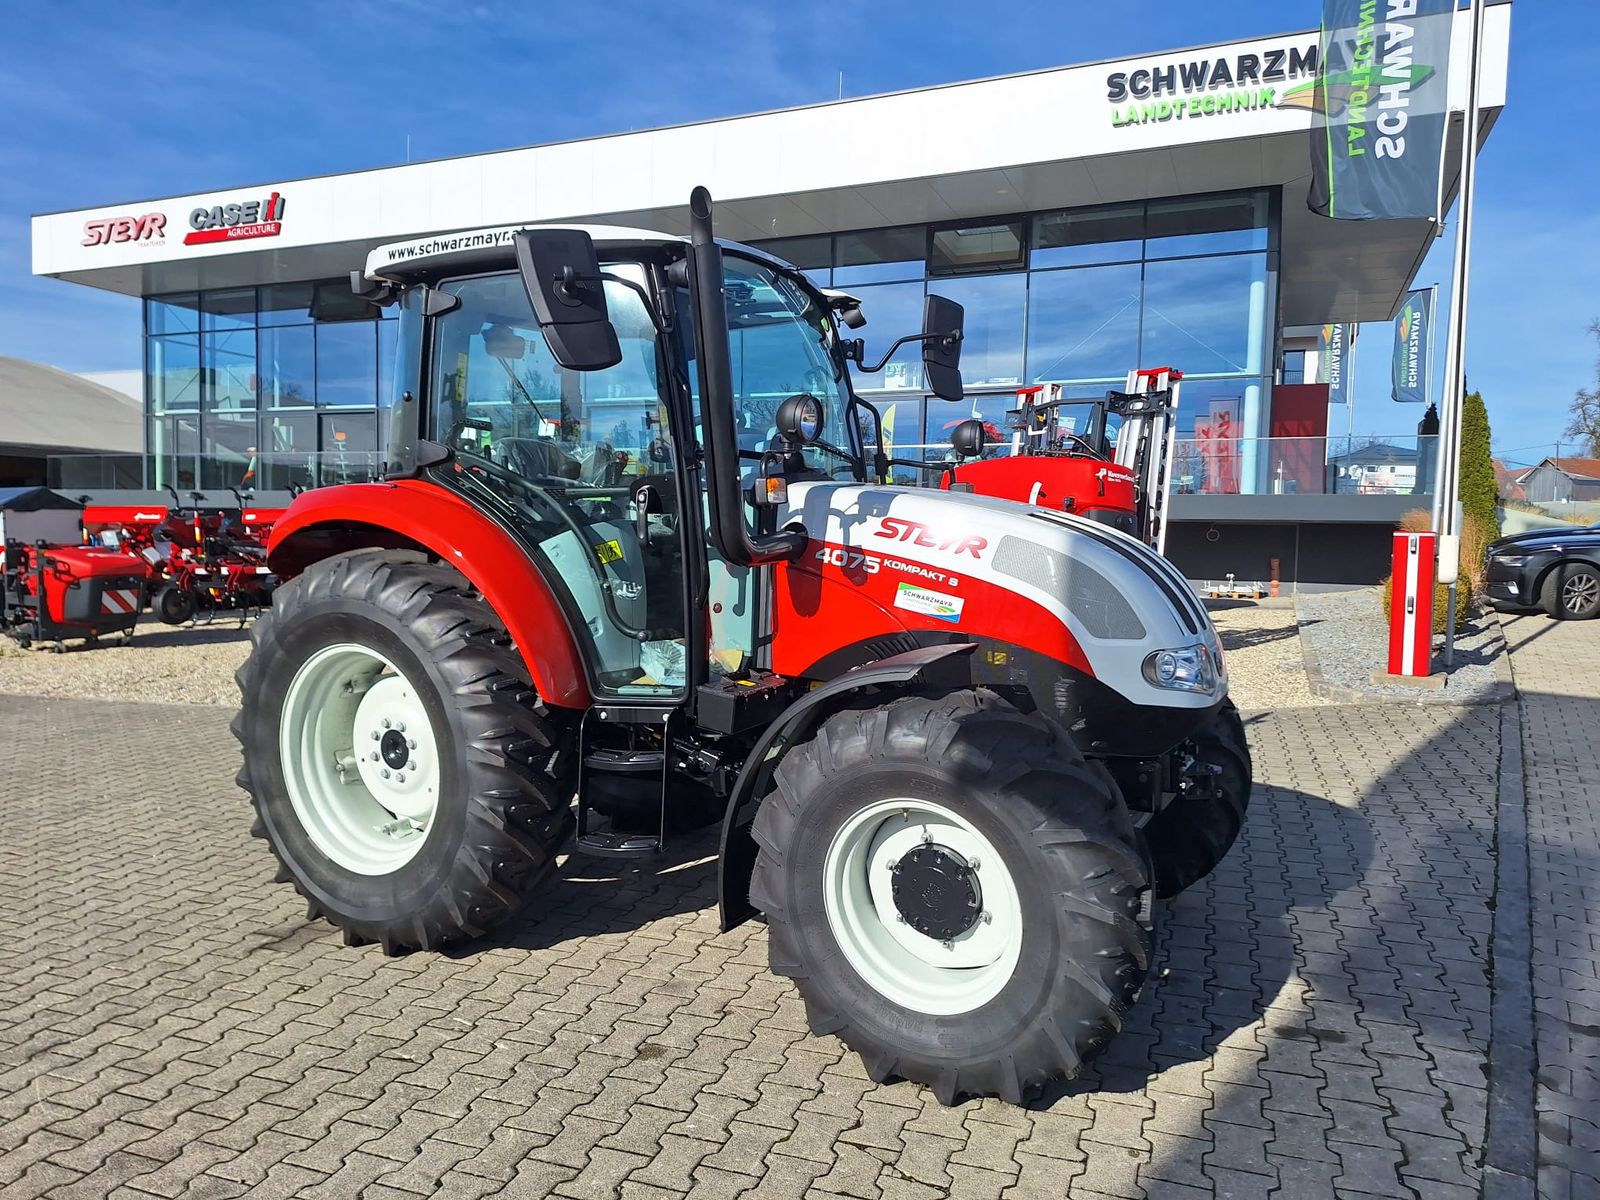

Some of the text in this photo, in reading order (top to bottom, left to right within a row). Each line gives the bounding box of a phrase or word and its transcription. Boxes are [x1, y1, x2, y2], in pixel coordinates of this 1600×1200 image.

[1111, 86, 1275, 127] LANDTECHNIK
[81, 213, 167, 246] STEYR
[189, 201, 260, 231] CASE
[227, 224, 276, 238] AGRICULTURE
[815, 547, 959, 587] 4075 KOMPAKT S
[903, 590, 953, 607] SCHWARZMAYR
